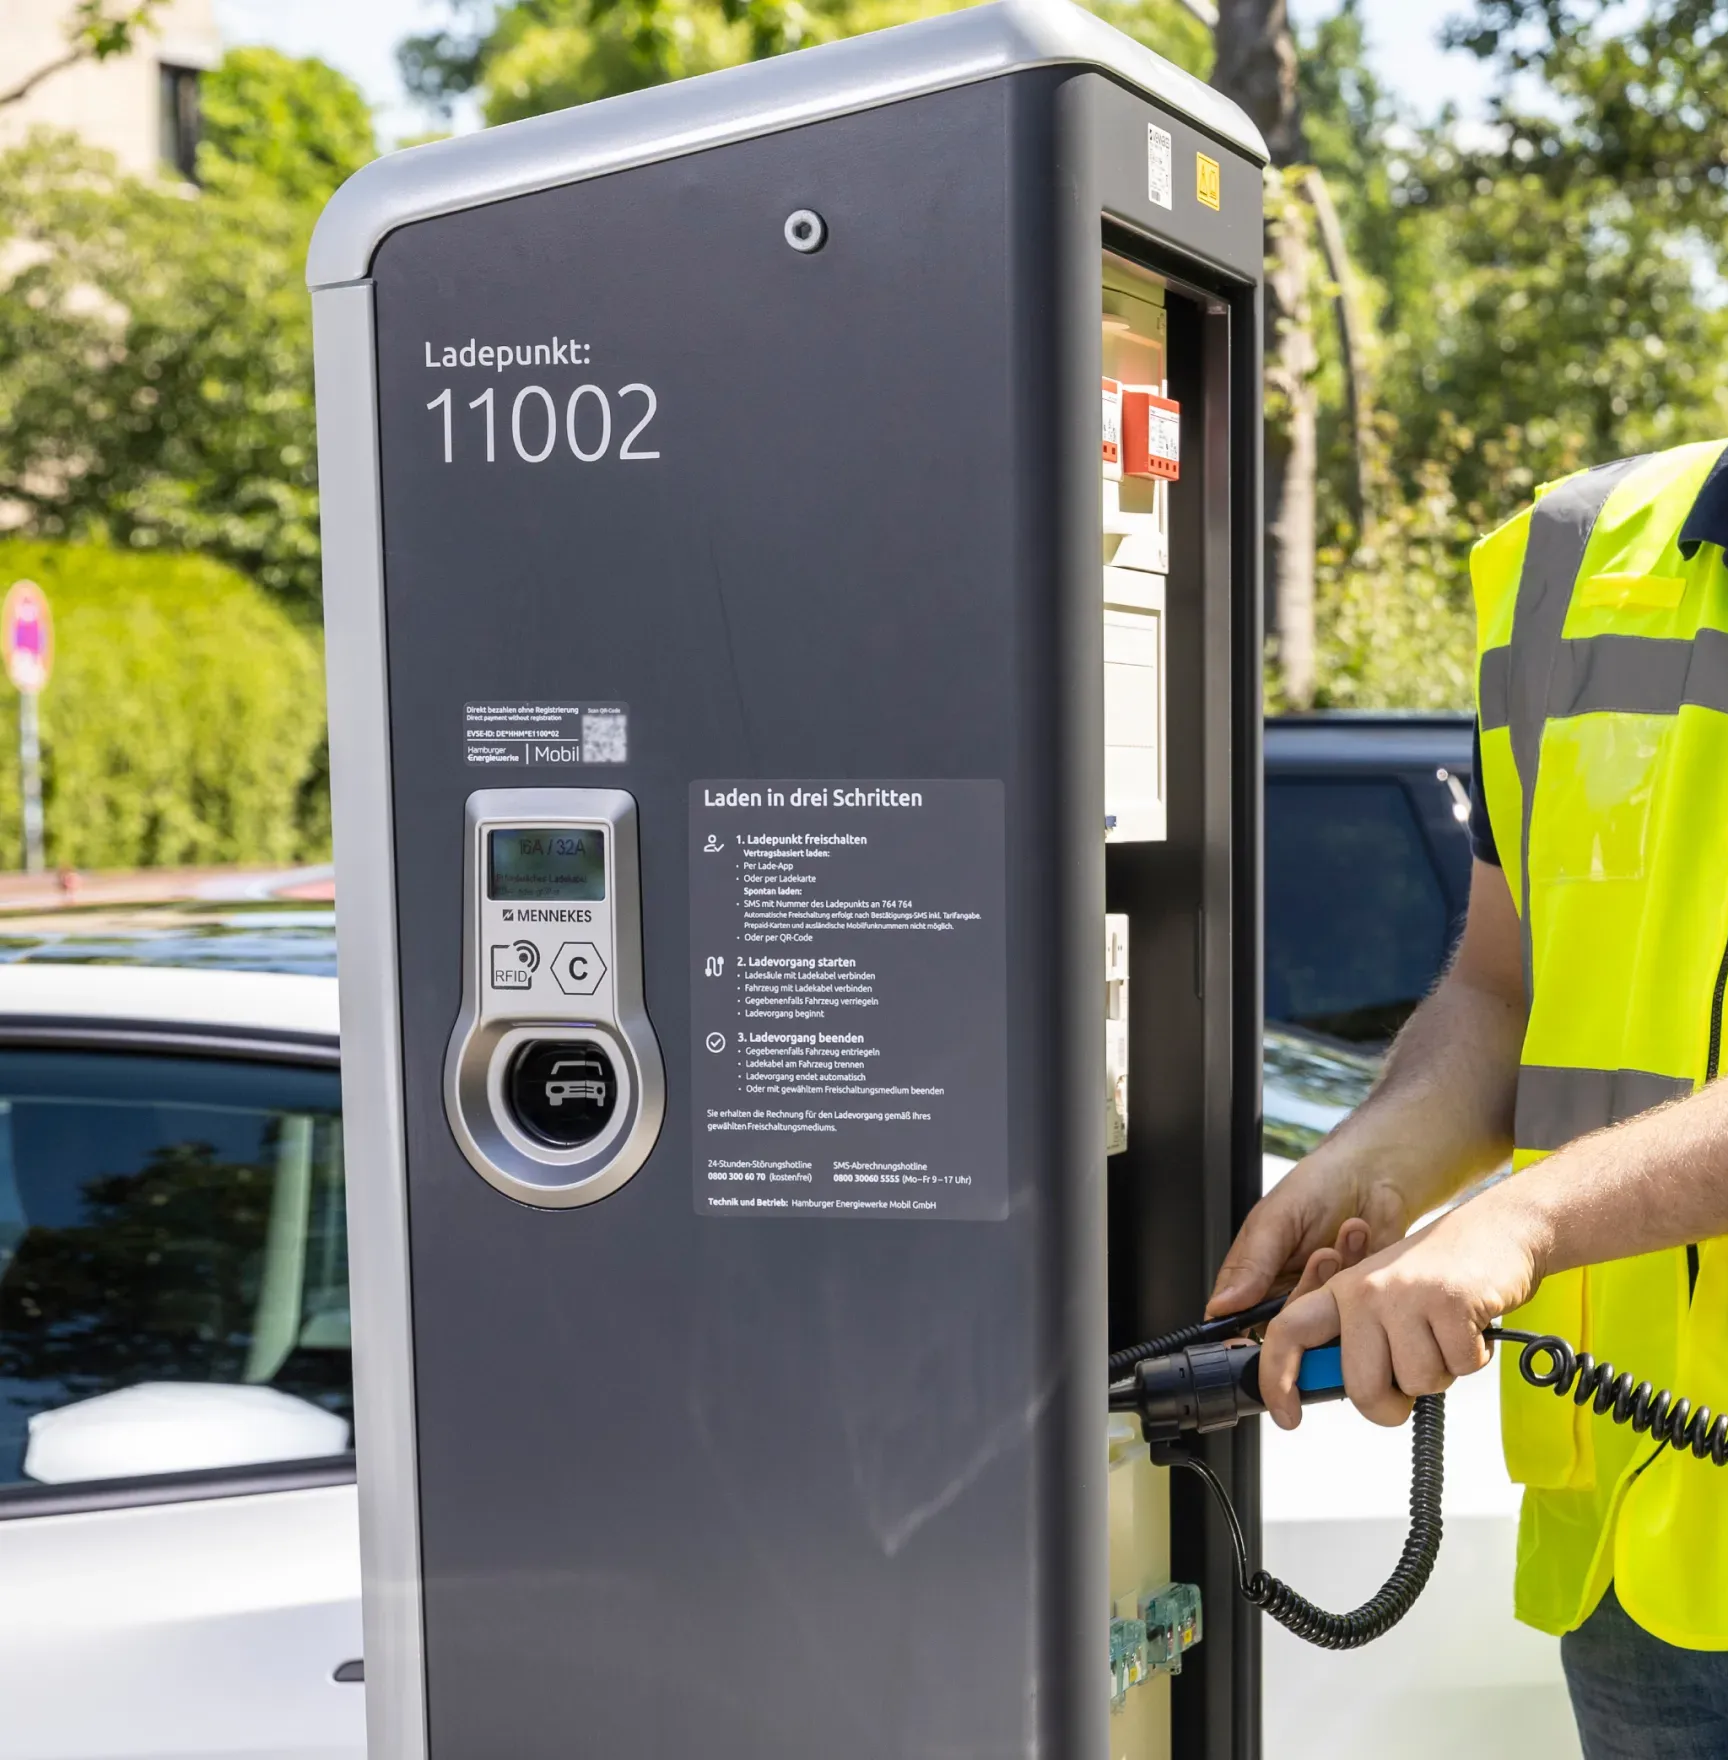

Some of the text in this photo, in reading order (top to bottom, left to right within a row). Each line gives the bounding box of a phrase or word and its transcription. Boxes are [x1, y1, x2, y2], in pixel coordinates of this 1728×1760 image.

[425, 336, 590, 372] Ladepunkt:
[426, 383, 660, 463] 11002
[536, 707, 579, 715] Registrierung
[467, 730, 495, 738] EVSE-ID:
[467, 746, 579, 763] Energiewerke Mobil
[468, 746, 506, 755] Hamburger
[705, 788, 922, 807] Laden in drei Schritten
[736, 833, 867, 846] 1. Ladepunkt freischalten
[556, 838, 586, 856] 32A
[743, 849, 830, 859] Vertragsbasiert laden:
[744, 861, 794, 871] Per Lade-App
[744, 874, 816, 884] Oder per Ladekarte
[744, 887, 802, 896] Spontan laden:
[744, 900, 761, 908] SMS
[762, 900, 775, 908] mit
[776, 900, 810, 908] Nummer
[810, 899, 824, 908] des
[826, 899, 870, 910] Ladepunkts
[882, 900, 896, 908] 764
[898, 900, 912, 908] 764
[518, 909, 592, 922] MENNEKES
[788, 911, 830, 920] Freischaltung
[831, 911, 854, 920] erfolgt
[854, 911, 870, 919] nach
[871, 912, 928, 920] Bestätigungs-SMS
[943, 912, 982, 921] Tarifangabe.
[744, 921, 791, 930] Prepaid-Karten
[846, 922, 909, 930] Mobilfunknummern
[910, 922, 926, 930] nicht
[927, 922, 954, 931] möglich.
[744, 933, 813, 943] Oder per QR-Code
[569, 956, 588, 980] C
[737, 956, 856, 969] 2. Ladevorgang starten
[496, 970, 528, 982] RFID
[745, 971, 876, 980] Ladesäule mit Ladekabel verbinden
[745, 984, 872, 994] Fahrzeug mit Ladekabel verbinden
[745, 996, 879, 1007] Gegebenenfalls Fahrzeug verriegeln
[745, 1009, 825, 1019] Ladevorgang beginnt
[738, 1032, 864, 1045] 3. Ladevorgang beenden
[745, 1047, 880, 1058] Gegebenenfalls Fahrzeug entriegeln
[746, 1059, 784, 1068] Ladekabel
[798, 1060, 833, 1070] Fahrzeug
[746, 1072, 866, 1082] Ladevorgang endet automatisch
[746, 1084, 944, 1096] Oder mit gewähltem Freischaltungsmedium beenden
[707, 1109, 931, 1121] Sie erhalten die Rechnung für den Ladevorgang gemäß Ihres
[707, 1122, 837, 1133] gewählten Freischaltungsmediums.
[708, 1159, 812, 1170] 24-Stunden-Störungshotline
[833, 1161, 928, 1172] SMS-Abrechnungshotline
[708, 1172, 812, 1183] 0800 300 60 70 (kostenfrei)
[833, 1174, 853, 1182] 0800
[854, 1174, 879, 1182] 30060
[880, 1174, 900, 1183] 5555
[902, 1175, 931, 1184] (Mo–Fr
[955, 1175, 972, 1185] Uhr)
[708, 1197, 936, 1210] Technik und Betrieb: Hamburger Energiewerke Mobil GmbH
